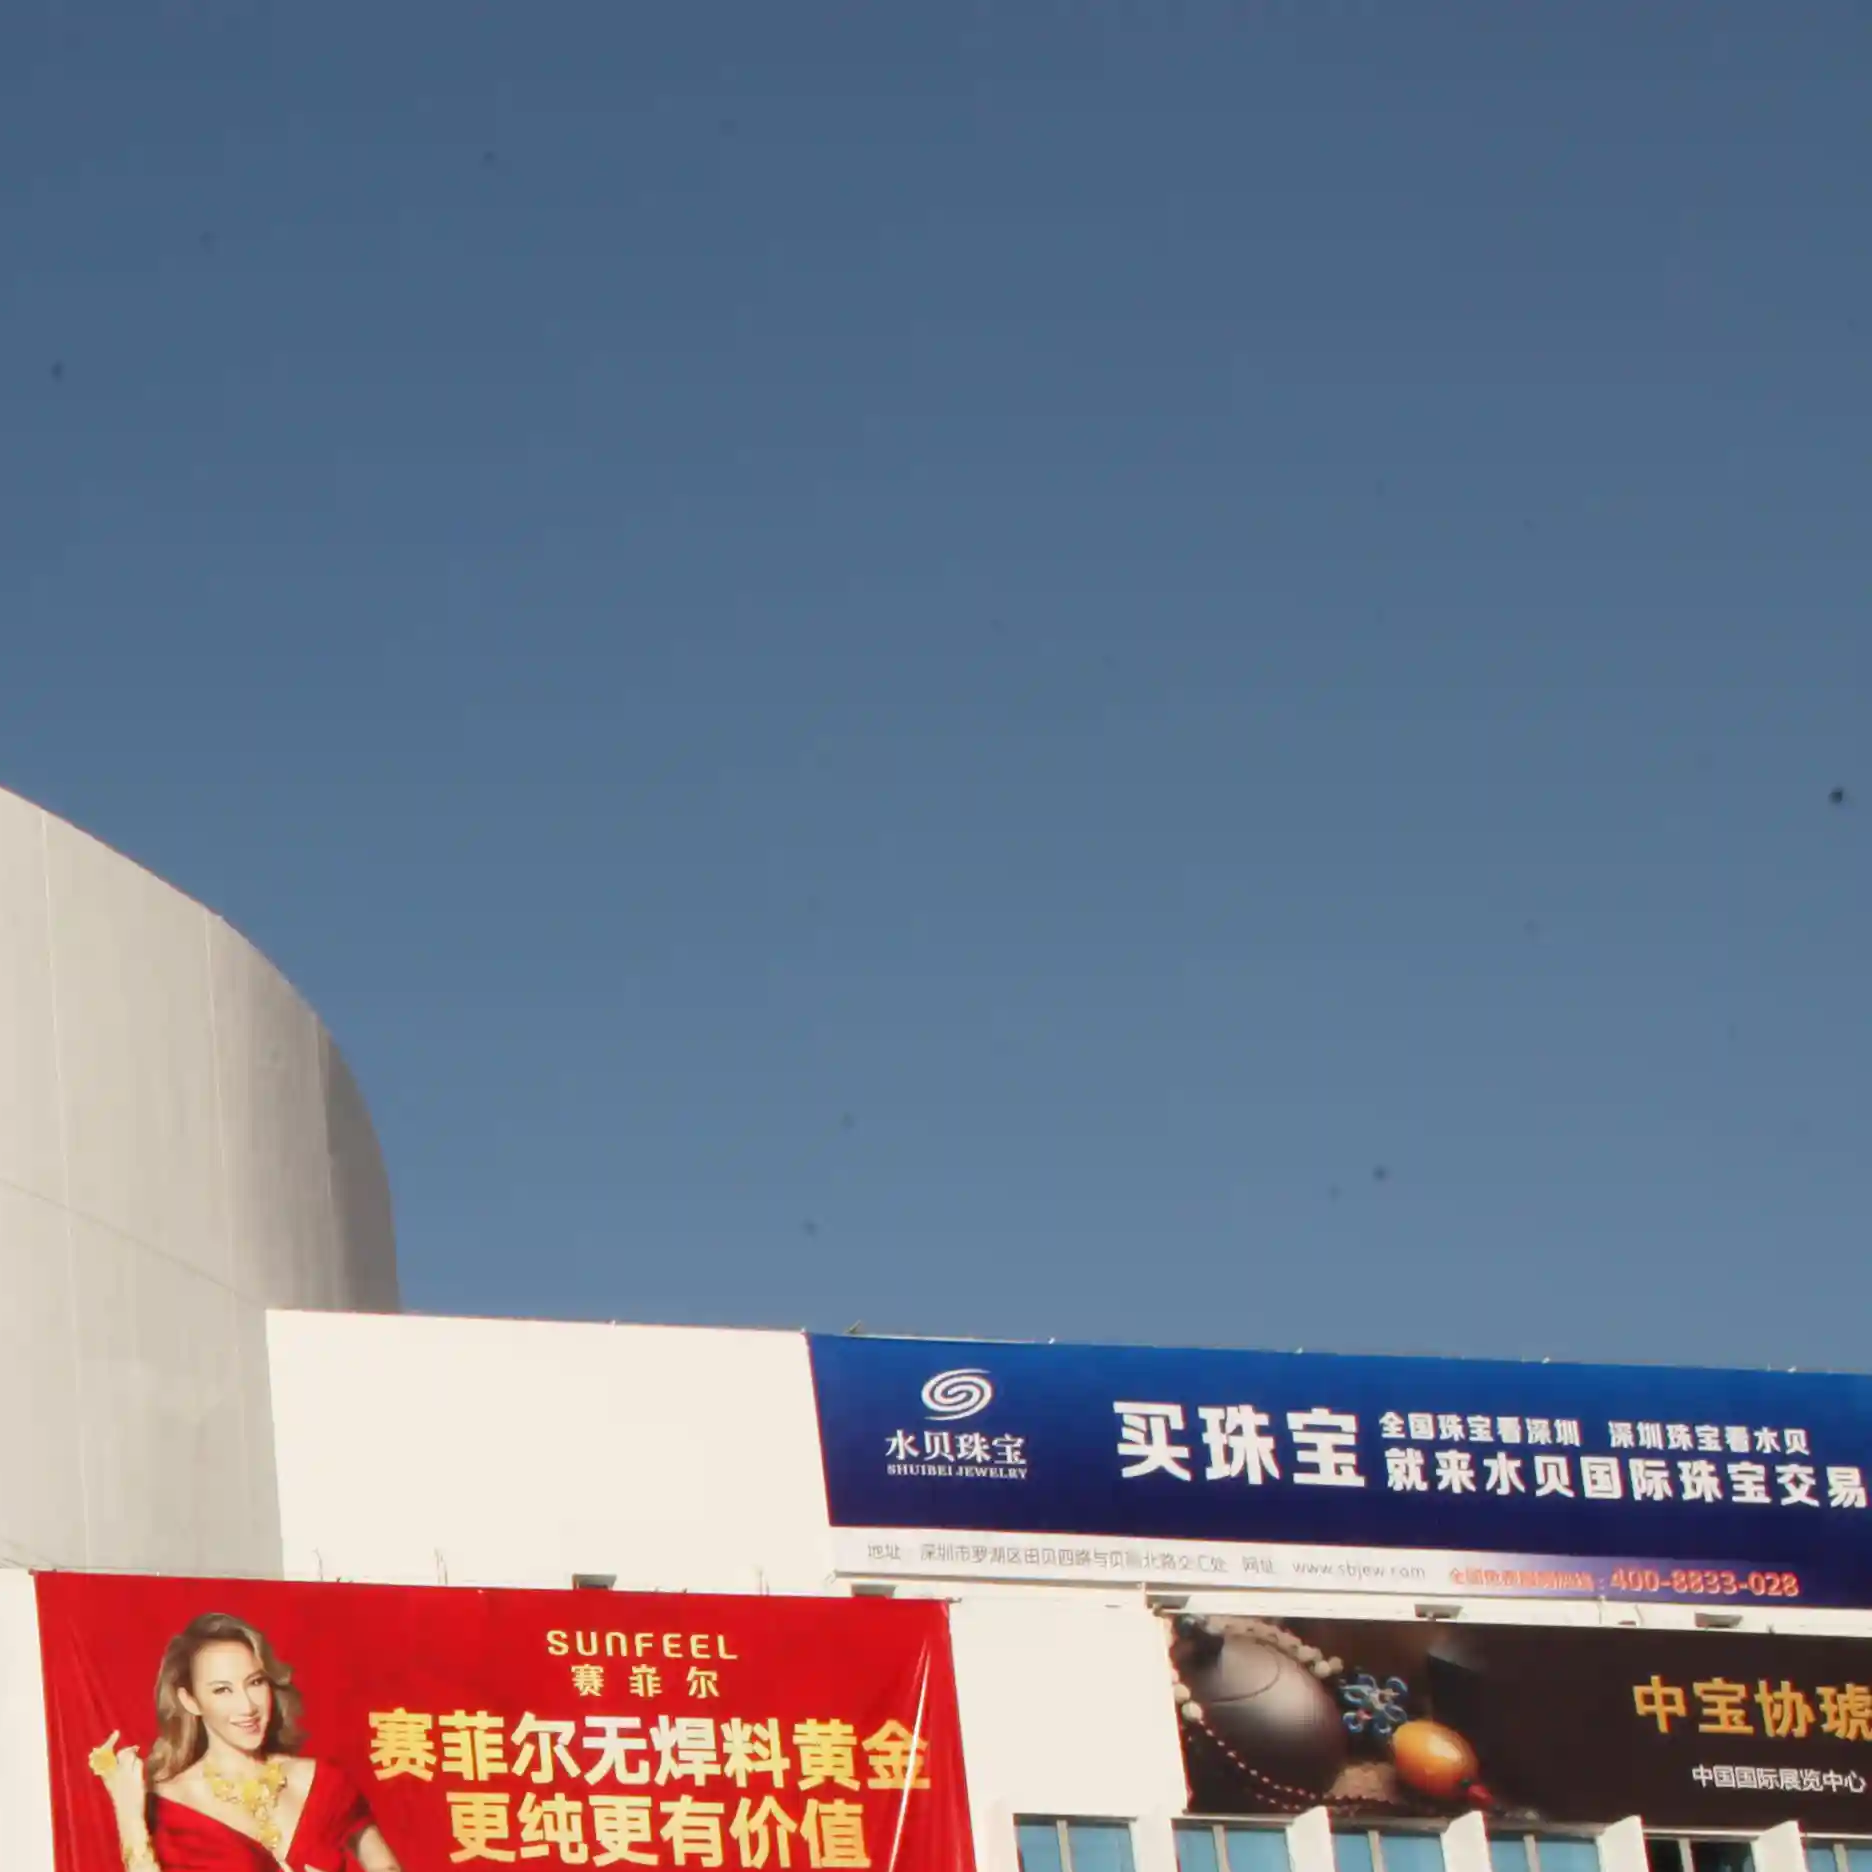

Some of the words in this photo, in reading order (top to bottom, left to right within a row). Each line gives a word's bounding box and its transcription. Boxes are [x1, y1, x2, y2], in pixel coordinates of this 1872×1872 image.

[885, 1430, 1027, 1466] 水贝珠宝
[1113, 1400, 1366, 1488] 买珠宝
[886, 1463, 953, 1478] SHUIBEI
[955, 1464, 1028, 1480] JEWELRY
[1384, 1447, 1868, 1510] 就来水贝国际珠宝交易
[546, 1628, 738, 1660] SUNFEEL
[570, 1663, 721, 1699] 赛菲尔
[368, 1707, 931, 1792] 赛菲尔无焊料黄金
[1691, 1763, 1868, 1794] 中国国际展览中心
[446, 1790, 872, 1870] 更纯更有价值
